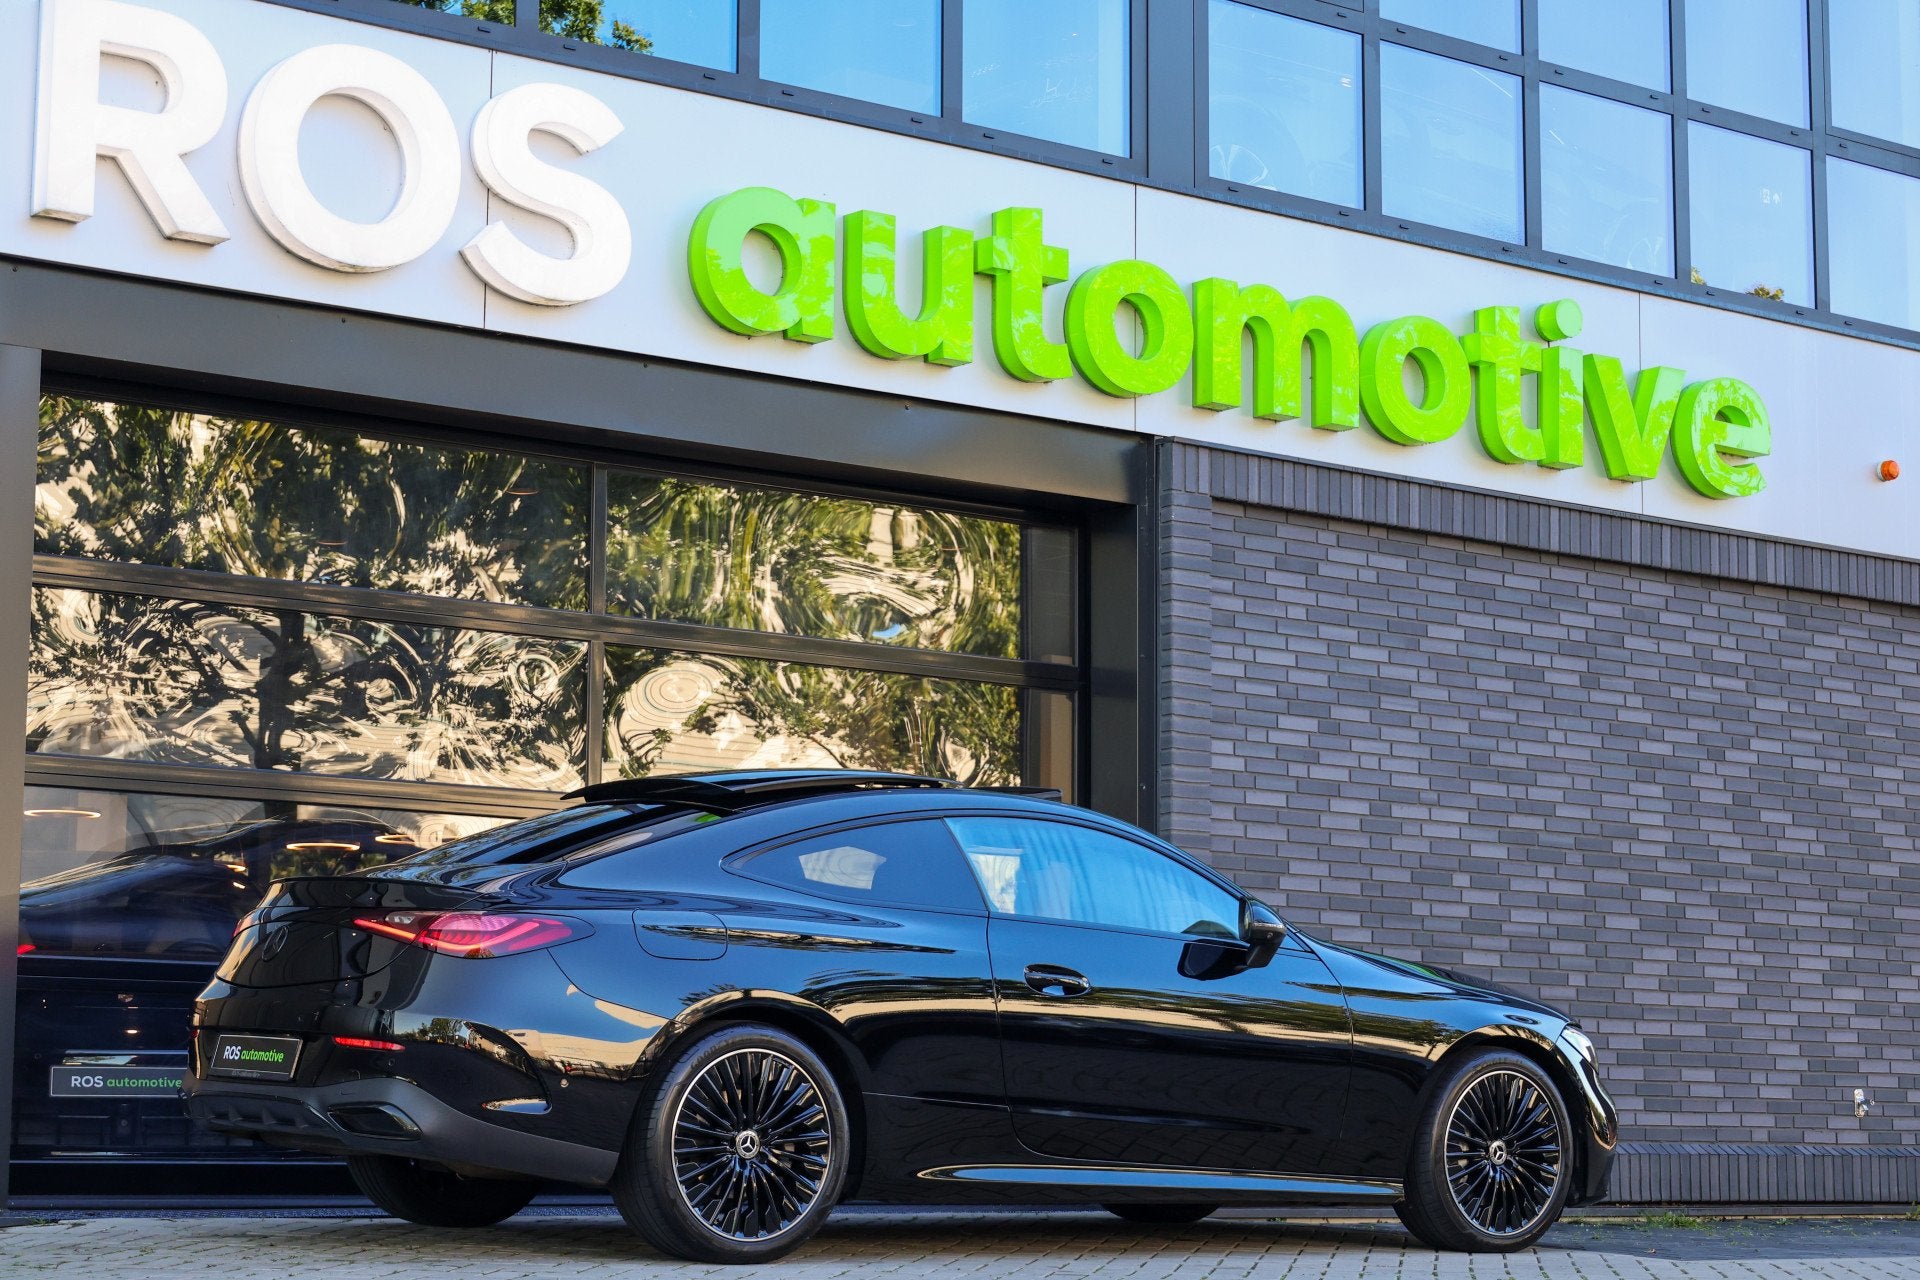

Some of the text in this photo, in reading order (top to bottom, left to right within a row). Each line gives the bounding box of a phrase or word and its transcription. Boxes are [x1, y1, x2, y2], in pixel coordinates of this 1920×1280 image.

[32, 0, 1771, 499] ROS automotive
[223, 1045, 284, 1062] ROS automotive
[70, 1076, 182, 1088] ROS automotive
